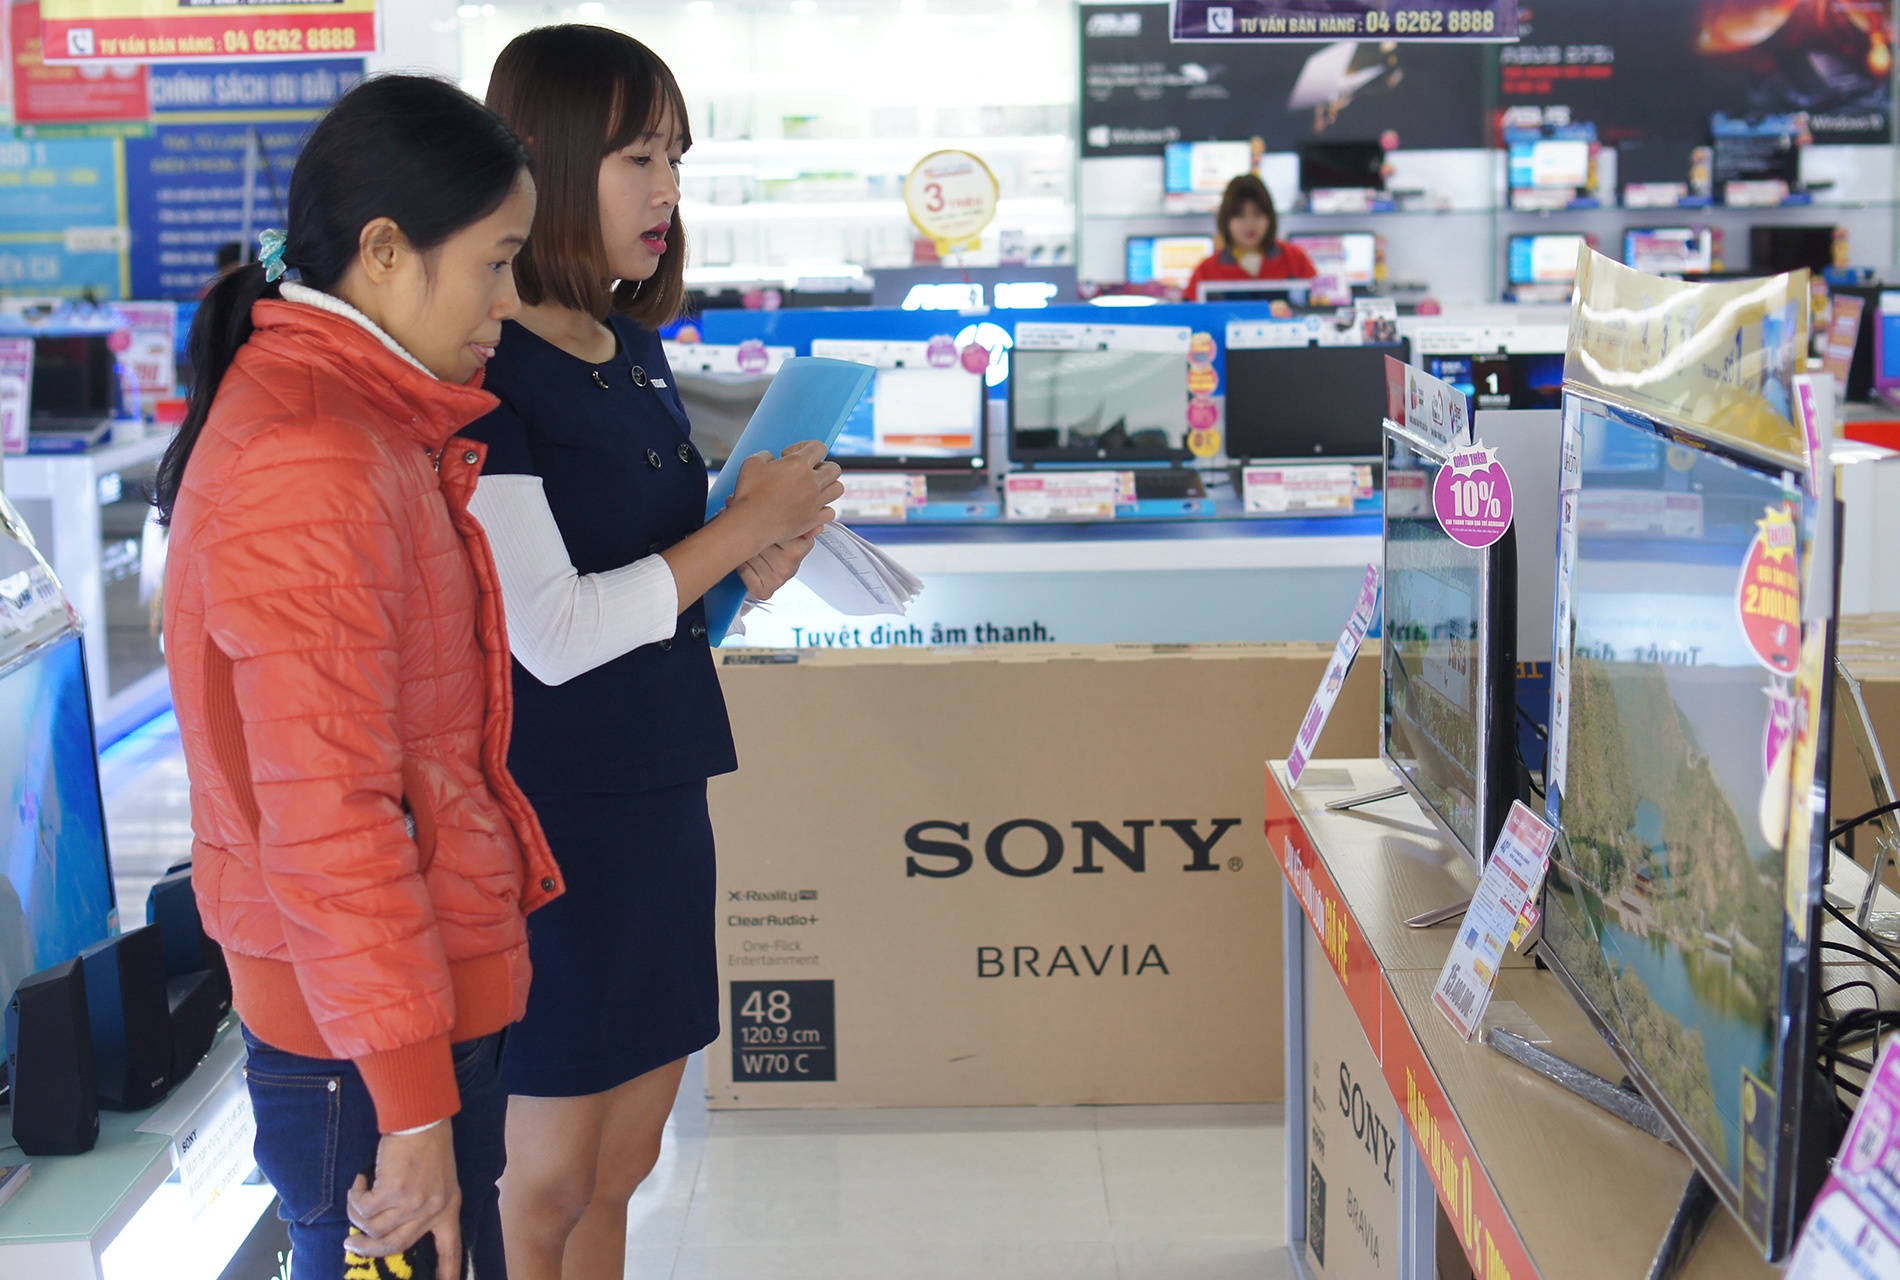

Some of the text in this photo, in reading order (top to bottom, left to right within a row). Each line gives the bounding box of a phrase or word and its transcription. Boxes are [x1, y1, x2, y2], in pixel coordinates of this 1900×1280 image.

[1259, 13, 1286, 32] VẤN
[1289, 14, 1317, 32] BÁN
[1319, 14, 1355, 32] HÀNG
[1365, 11, 1390, 33] 04
[1395, 11, 1443, 33] 6262
[1447, 10, 1495, 33] 8888
[223, 29, 249, 53] 04
[253, 28, 303, 51] 6262
[307, 27, 356, 50] 8888
[924, 182, 945, 212] 3
[1450, 480, 1501, 519] 10%
[930, 622, 967, 645] âm
[975, 620, 1056, 644] thanh.
[904, 818, 1241, 879] SONY
[728, 914, 819, 927] ClearAudio+
[1324, 897, 1337, 964] GIÁ
[742, 940, 801, 953] One-Flick
[728, 954, 819, 967] Entertainment
[977, 944, 1170, 978] BRAVIA
[740, 990, 792, 1024] 48
[741, 1026, 820, 1044] 120.9 cm
[742, 1053, 809, 1074] W70 C
[1339, 1061, 1396, 1187] SONY
[181, 1128, 198, 1153] SONY
[1347, 1187, 1380, 1268] BRAVIA
